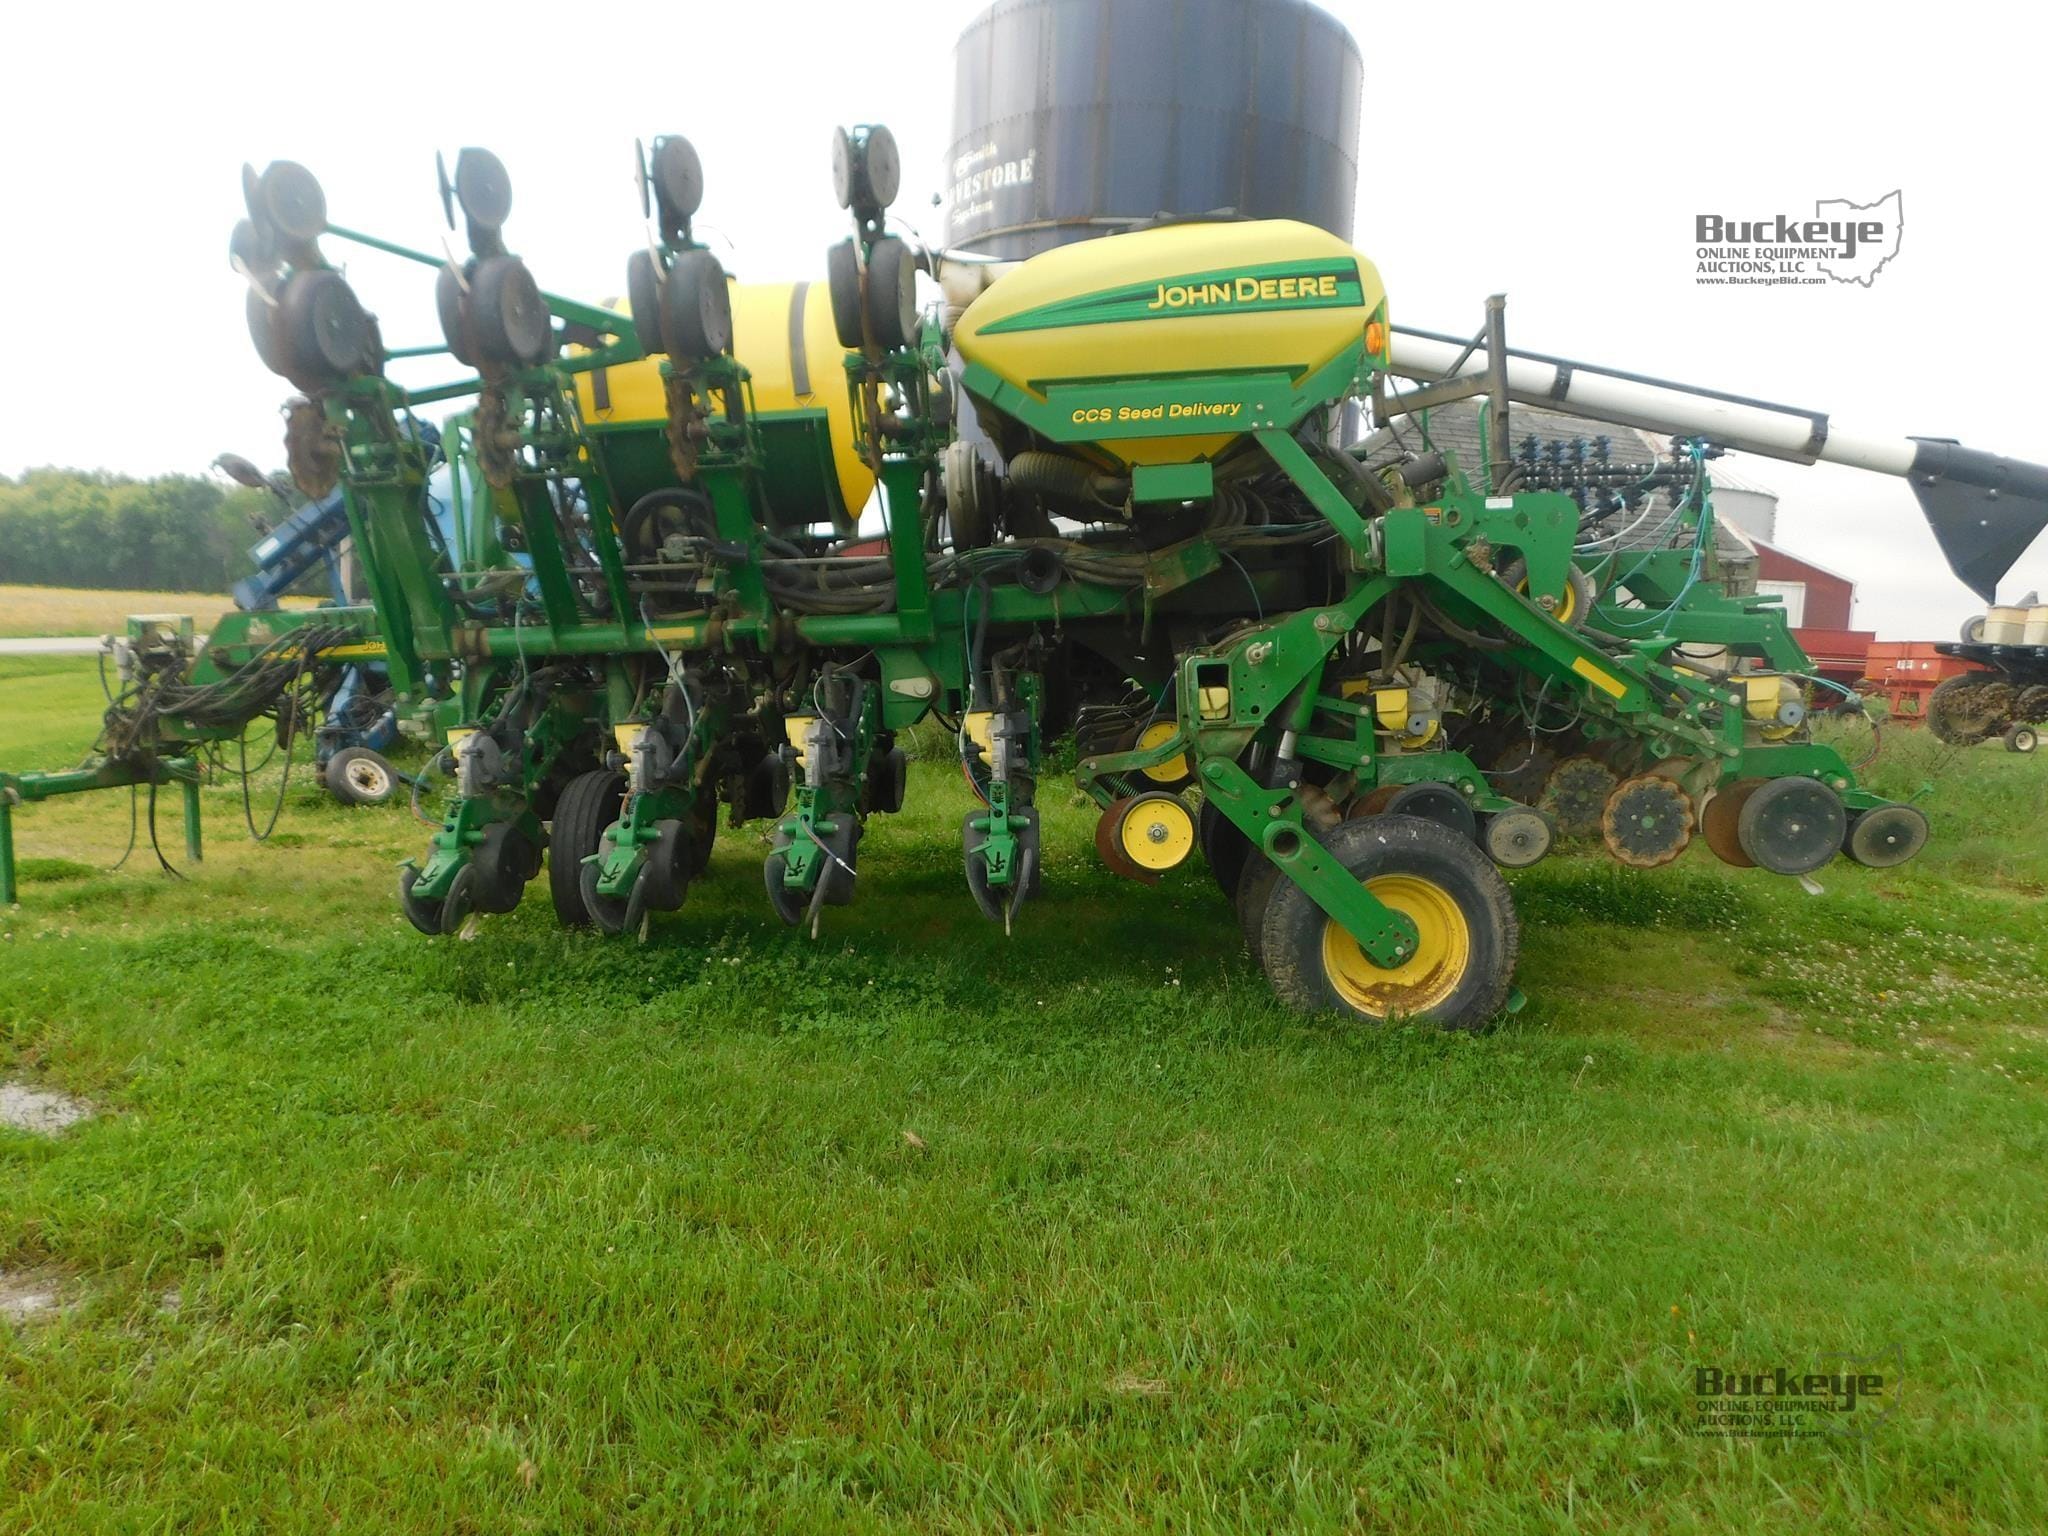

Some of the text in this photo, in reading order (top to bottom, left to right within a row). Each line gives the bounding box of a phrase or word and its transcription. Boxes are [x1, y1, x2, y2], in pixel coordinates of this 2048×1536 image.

[1148, 276, 1337, 309] JOHN DEERE
[1072, 402, 1242, 423] CCS Seed Delivery
[362, 640, 386, 651] JOH
